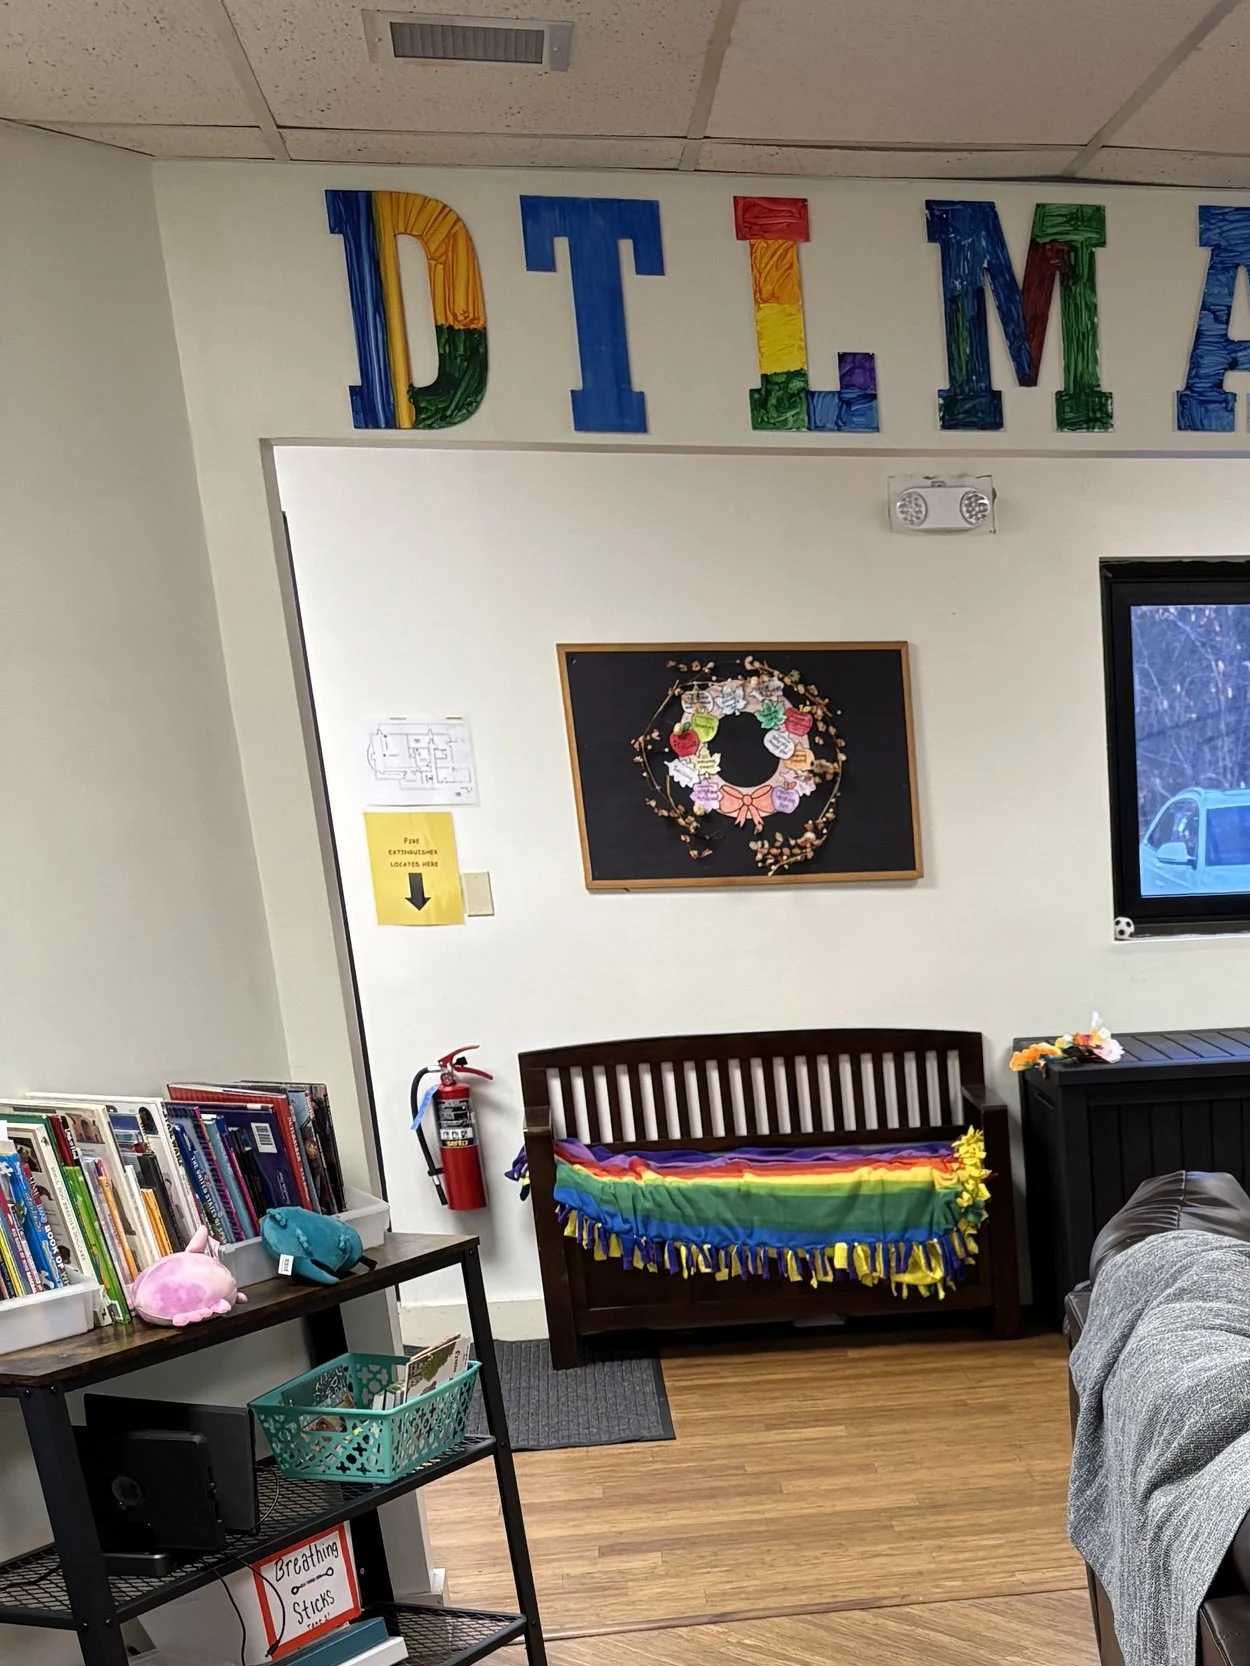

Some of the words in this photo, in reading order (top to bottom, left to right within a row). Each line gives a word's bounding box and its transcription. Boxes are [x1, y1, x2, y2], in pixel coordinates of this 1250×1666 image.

[404, 837, 419, 845] FIRE
[189, 1155, 199, 1169] THE
[194, 1168, 208, 1194] UNITED
[203, 1193, 218, 1218] STATES
[213, 1216, 221, 1226] OF
[217, 1226, 228, 1244] SPOR
[43, 1223, 60, 1254] BOOK
[54, 1255, 65, 1270] OF
[59, 1270, 71, 1286] WH
[274, 1541, 339, 1582] Breathing
